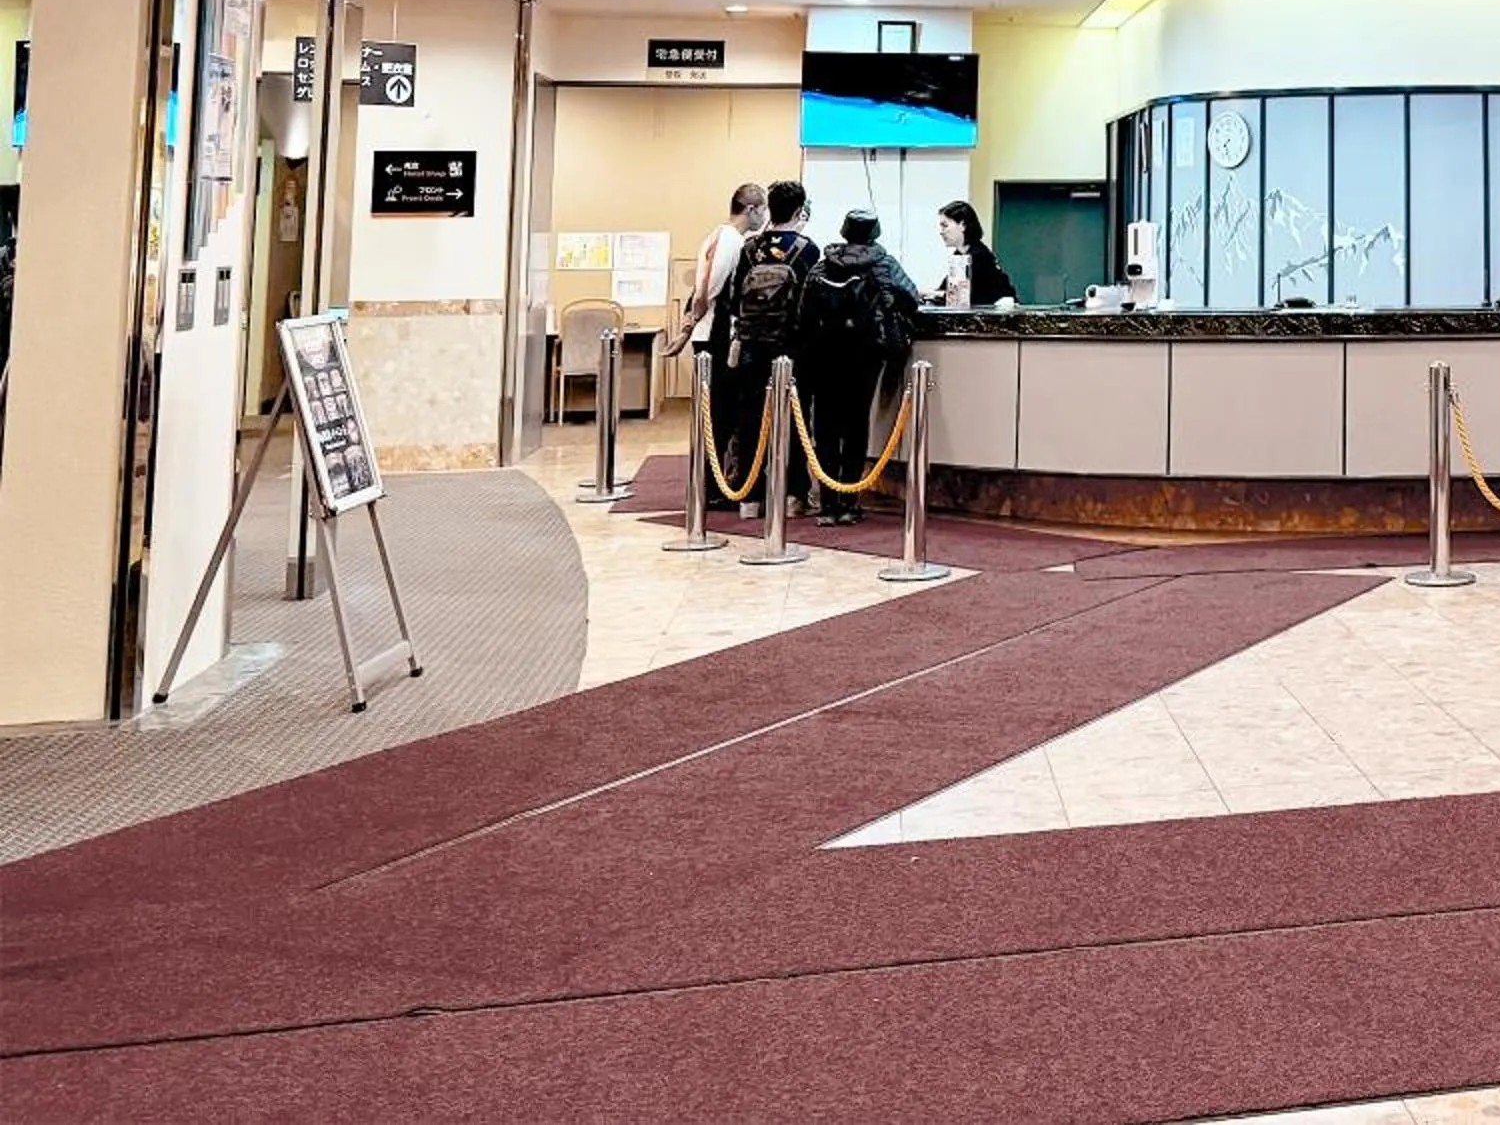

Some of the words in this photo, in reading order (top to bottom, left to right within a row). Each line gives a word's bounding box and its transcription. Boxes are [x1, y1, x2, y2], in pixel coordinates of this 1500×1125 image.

[655, 48, 718, 62] 宅急便受付
